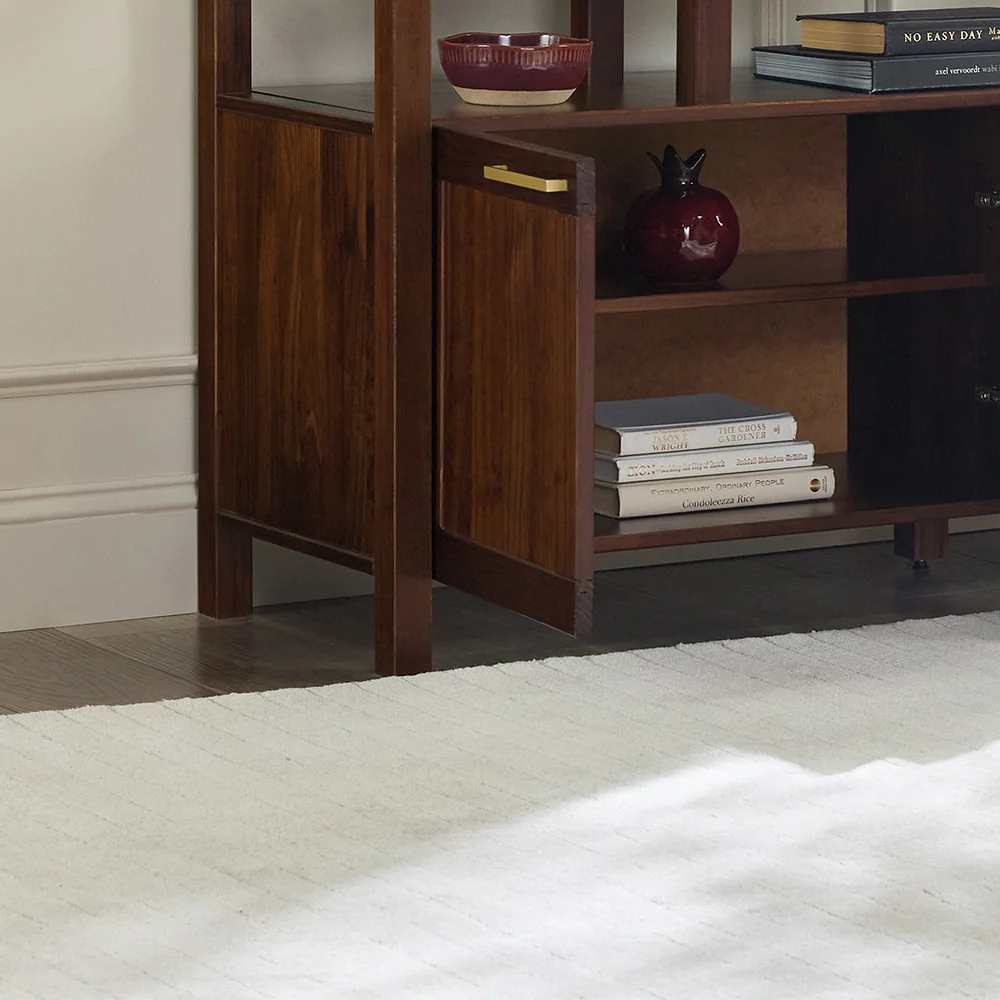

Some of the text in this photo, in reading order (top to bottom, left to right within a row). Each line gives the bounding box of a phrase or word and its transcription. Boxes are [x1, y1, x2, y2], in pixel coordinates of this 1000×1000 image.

[904, 30, 983, 42] NO EASY DAY
[934, 67, 949, 75] axel
[950, 65, 980, 75] vervoordt
[718, 426, 735, 435] THE
[738, 423, 766, 433] CROSS
[652, 434, 681, 444] JASON
[718, 432, 766, 443] GARDENER
[651, 442, 688, 451] WRIGHT
[651, 478, 785, 496] EXTRAORDINARY, ORDINARY PEOPLE
[682, 495, 755, 509] Condoleezza Rice
